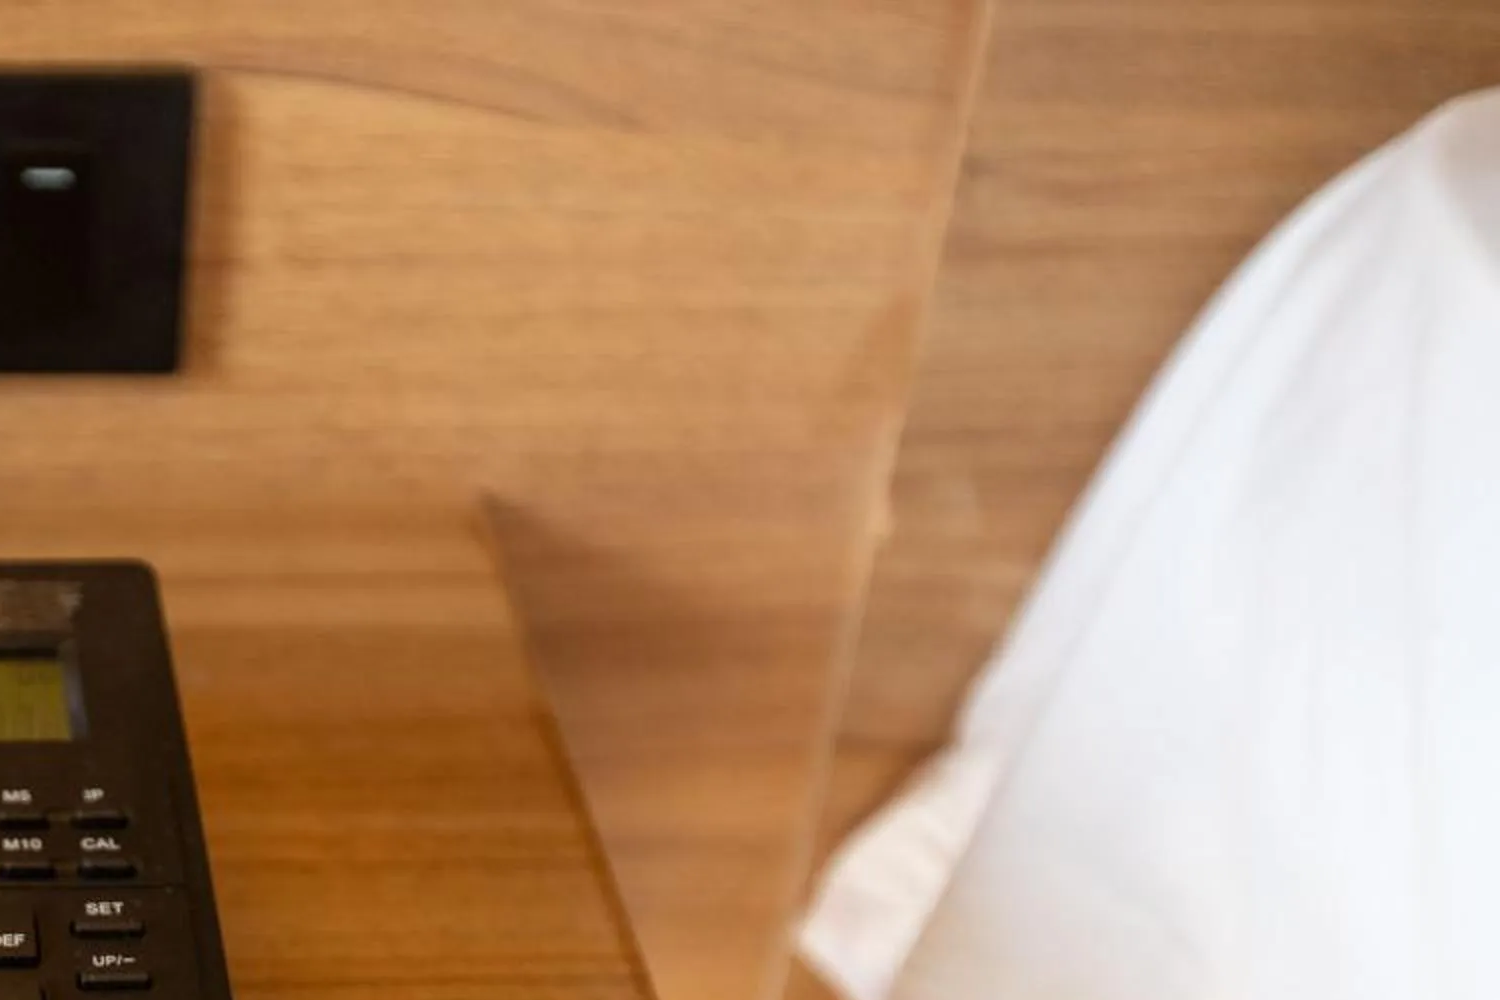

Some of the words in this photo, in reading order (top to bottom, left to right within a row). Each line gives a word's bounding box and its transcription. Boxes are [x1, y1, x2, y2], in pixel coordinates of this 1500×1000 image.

[2, 838, 43, 851] M10
[80, 837, 120, 851] CAL
[85, 901, 124, 916] SET
